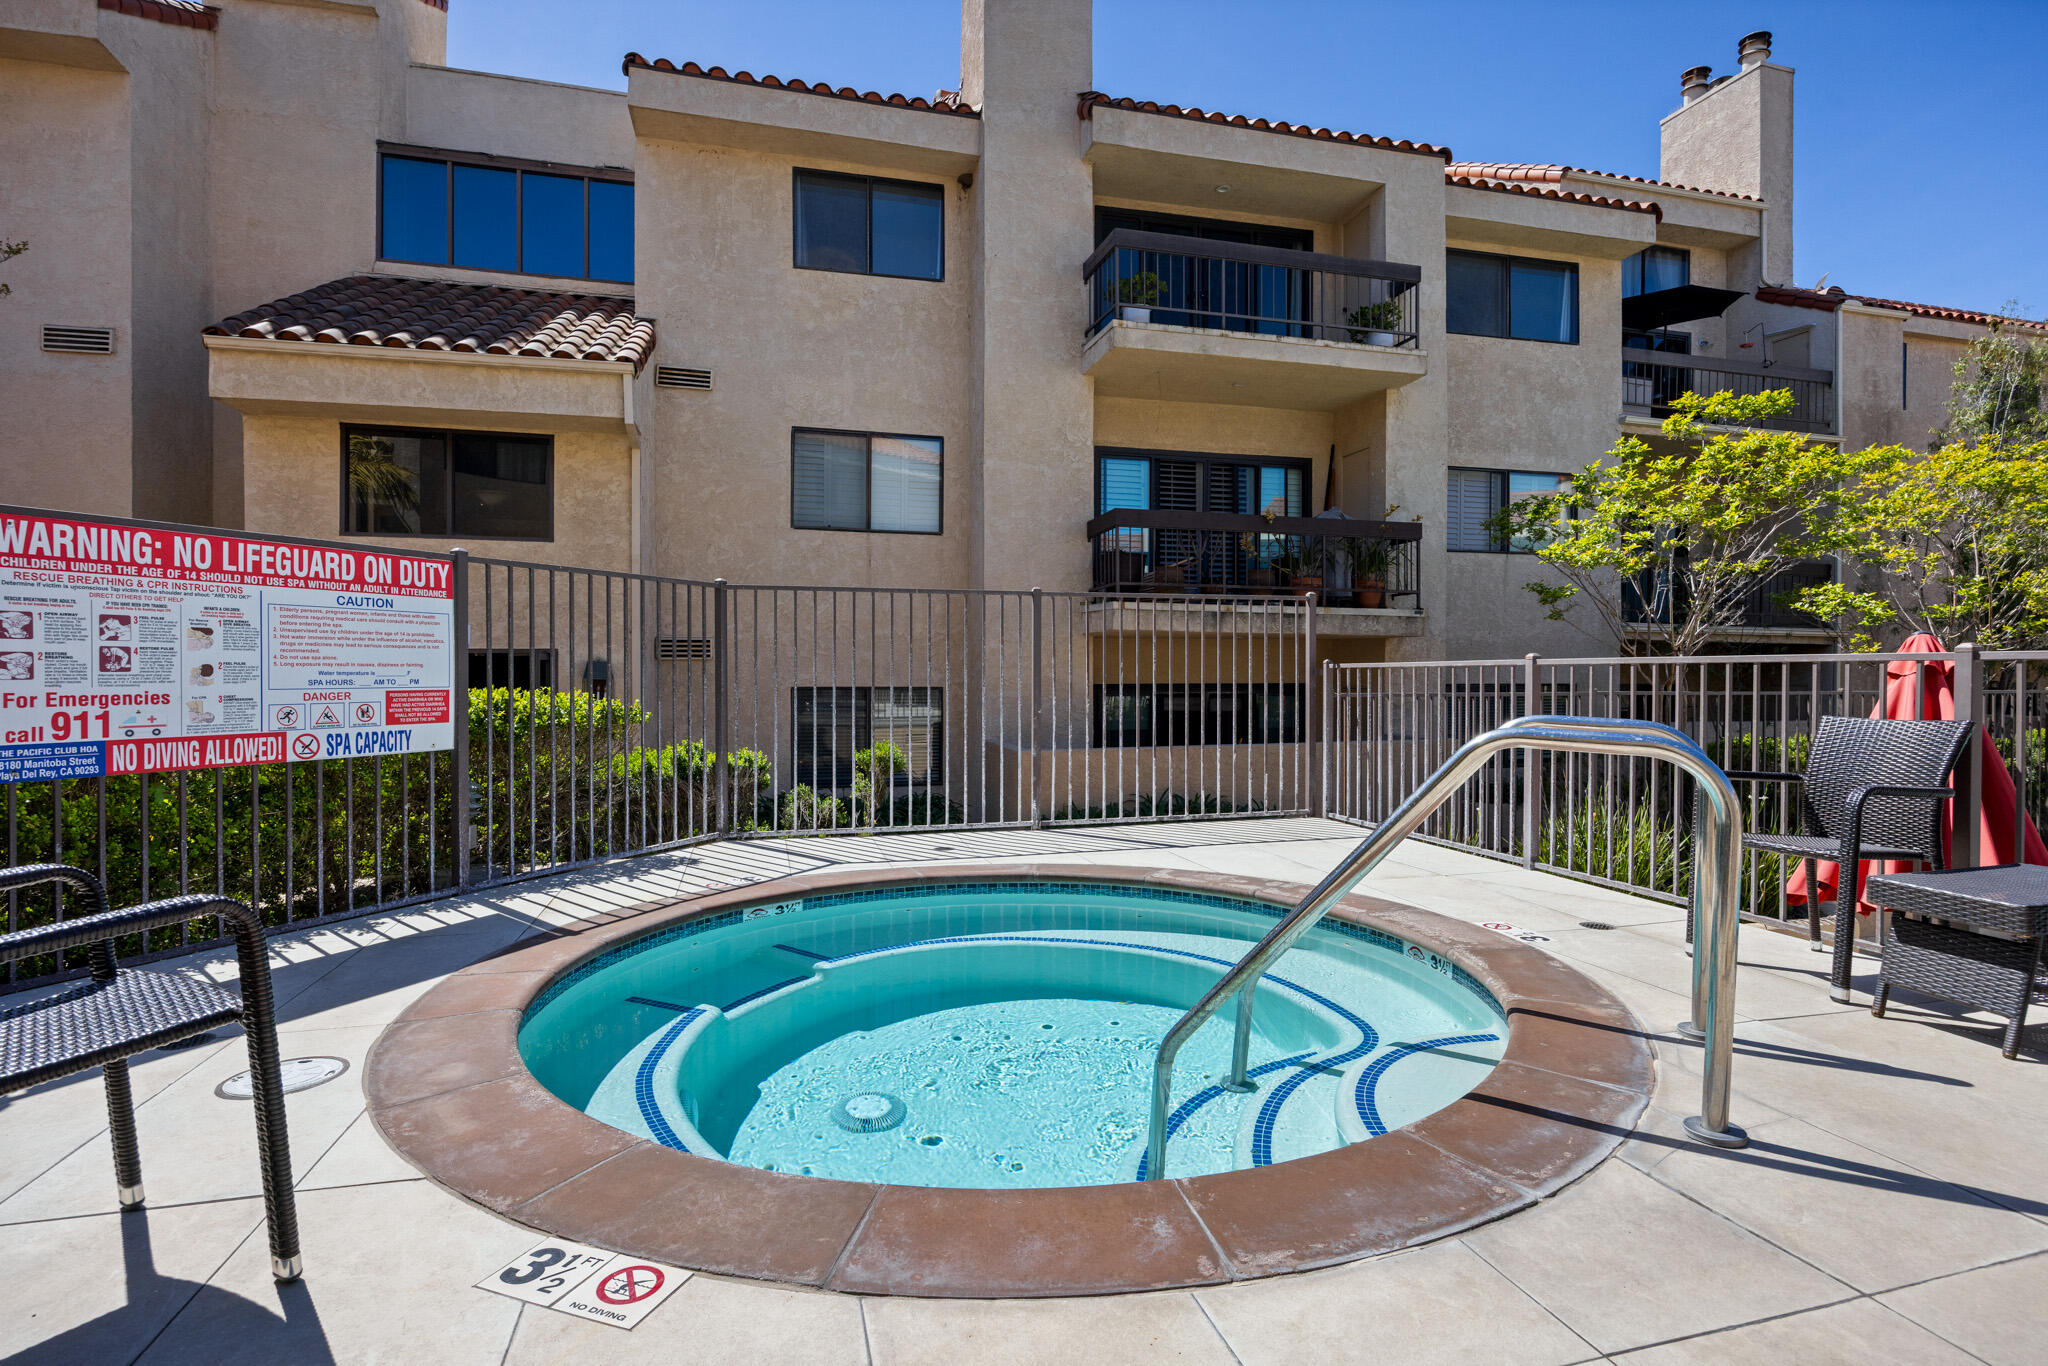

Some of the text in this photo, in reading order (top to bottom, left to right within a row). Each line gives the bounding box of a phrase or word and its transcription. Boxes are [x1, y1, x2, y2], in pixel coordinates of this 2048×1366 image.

[0, 516, 449, 589] WARNING: NO LIFEGUARD ON DUTY
[0, 555, 447, 597] CHILDREN UNDER THE AGE OF 14 SHOULD NOT USE SPA WITHOUT AN ADULT IN ATTENDANCE
[13, 570, 242, 594] RESCUE BREATHING & CPR INSTRUCTIONS
[1, 579, 34, 587] Determine
[336, 595, 393, 608] CAUTION
[37, 611, 41, 620] 1
[133, 616, 138, 624] 3
[218, 619, 221, 627] 1
[37, 652, 43, 660] 2
[133, 647, 138, 655] 4
[218, 661, 222, 669] 2
[3, 690, 170, 710] For Emergencies
[218, 695, 222, 703] 3
[303, 691, 351, 701] DANGER
[5, 710, 109, 743] call 911
[326, 728, 411, 756] SPA CAPACITY
[16, 748, 52, 756] PACIFIC
[54, 746, 77, 754] CLUB
[80, 745, 98, 753] HOA
[112, 735, 282, 772] NO DIVING ALLOWED!
[24, 757, 66, 768] Manitoba
[68, 756, 95, 765] Street
[0, 765, 99, 781] laya Del Rey, CA 90293
[581, 1256, 605, 1268] FT
[569, 1301, 627, 1322] NO DIVING
